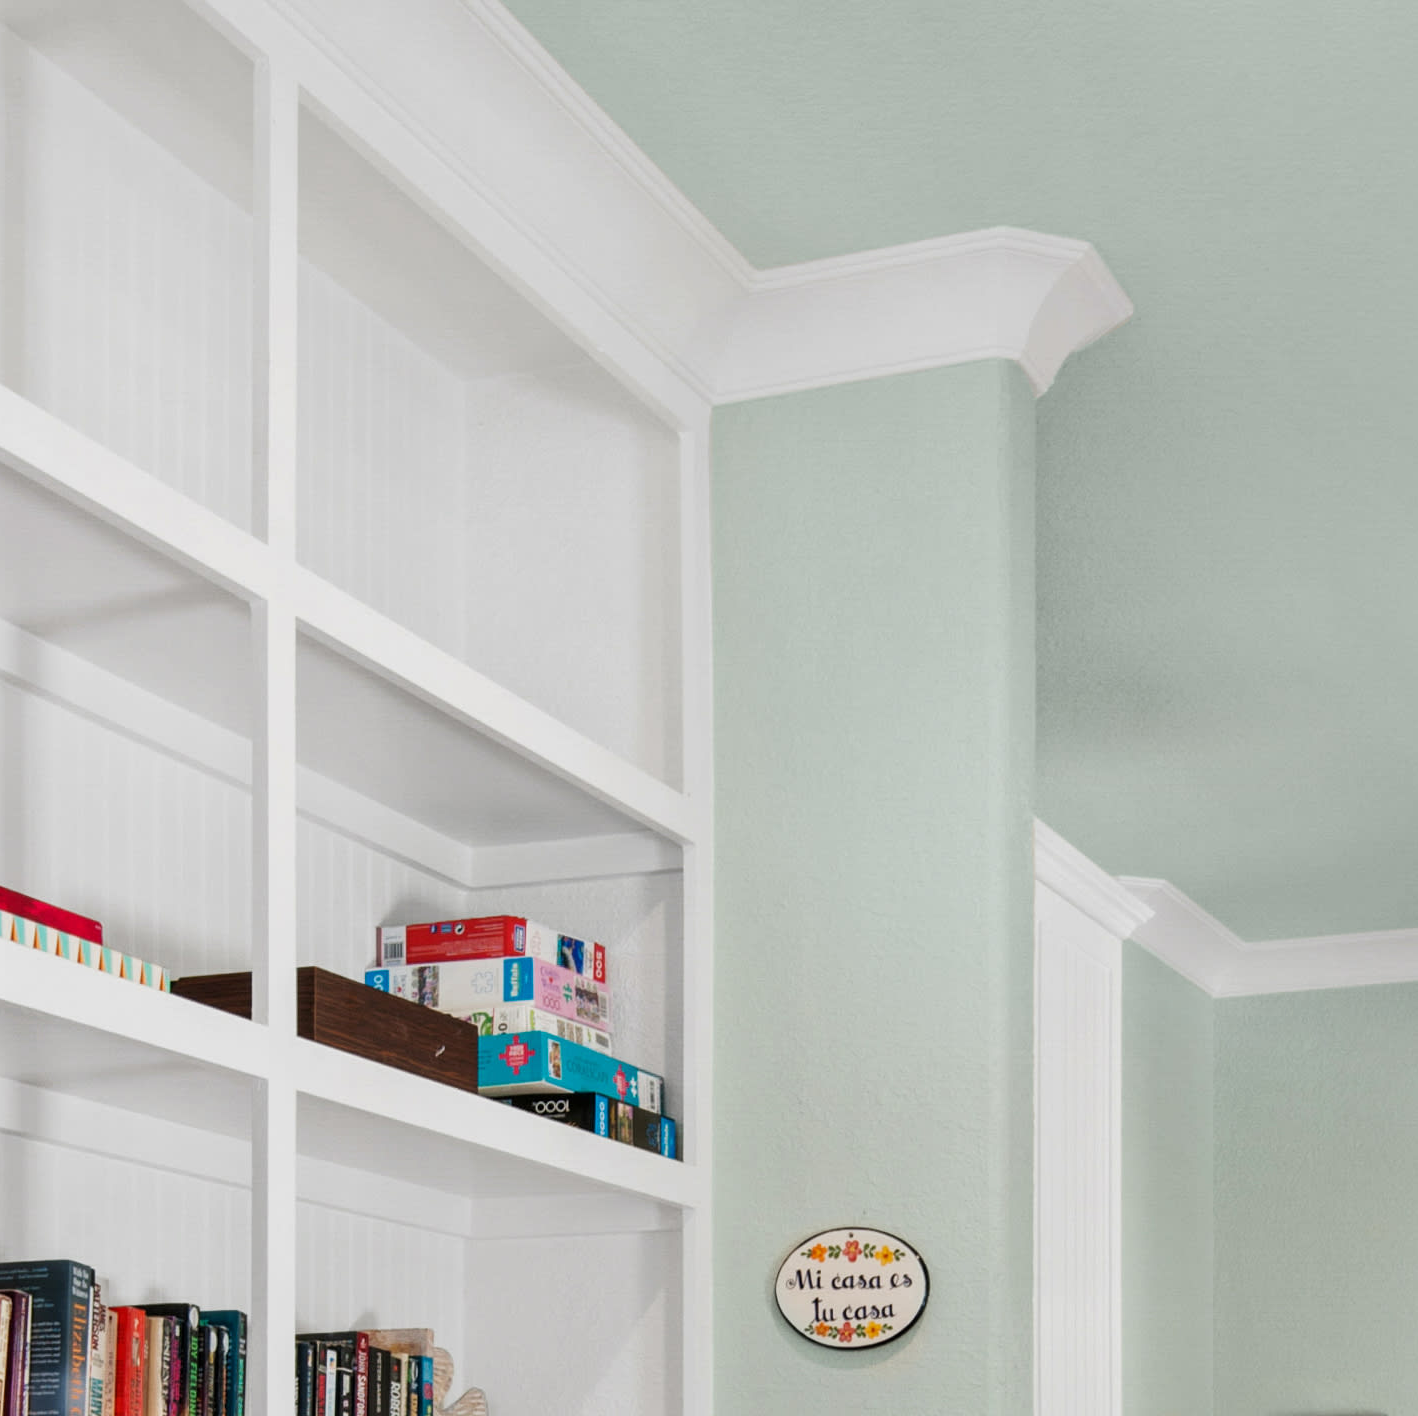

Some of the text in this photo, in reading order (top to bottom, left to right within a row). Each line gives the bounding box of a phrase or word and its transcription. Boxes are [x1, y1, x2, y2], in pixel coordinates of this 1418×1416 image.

[595, 951, 603, 979] 500
[786, 1268, 913, 1291] Mi casa es
[91, 1283, 101, 1350] PATTERSON
[810, 1297, 896, 1324] tu casa
[68, 1303, 87, 1402] Elizabeth
[357, 1350, 366, 1373] JOHN
[89, 1378, 103, 1416] MARY,
